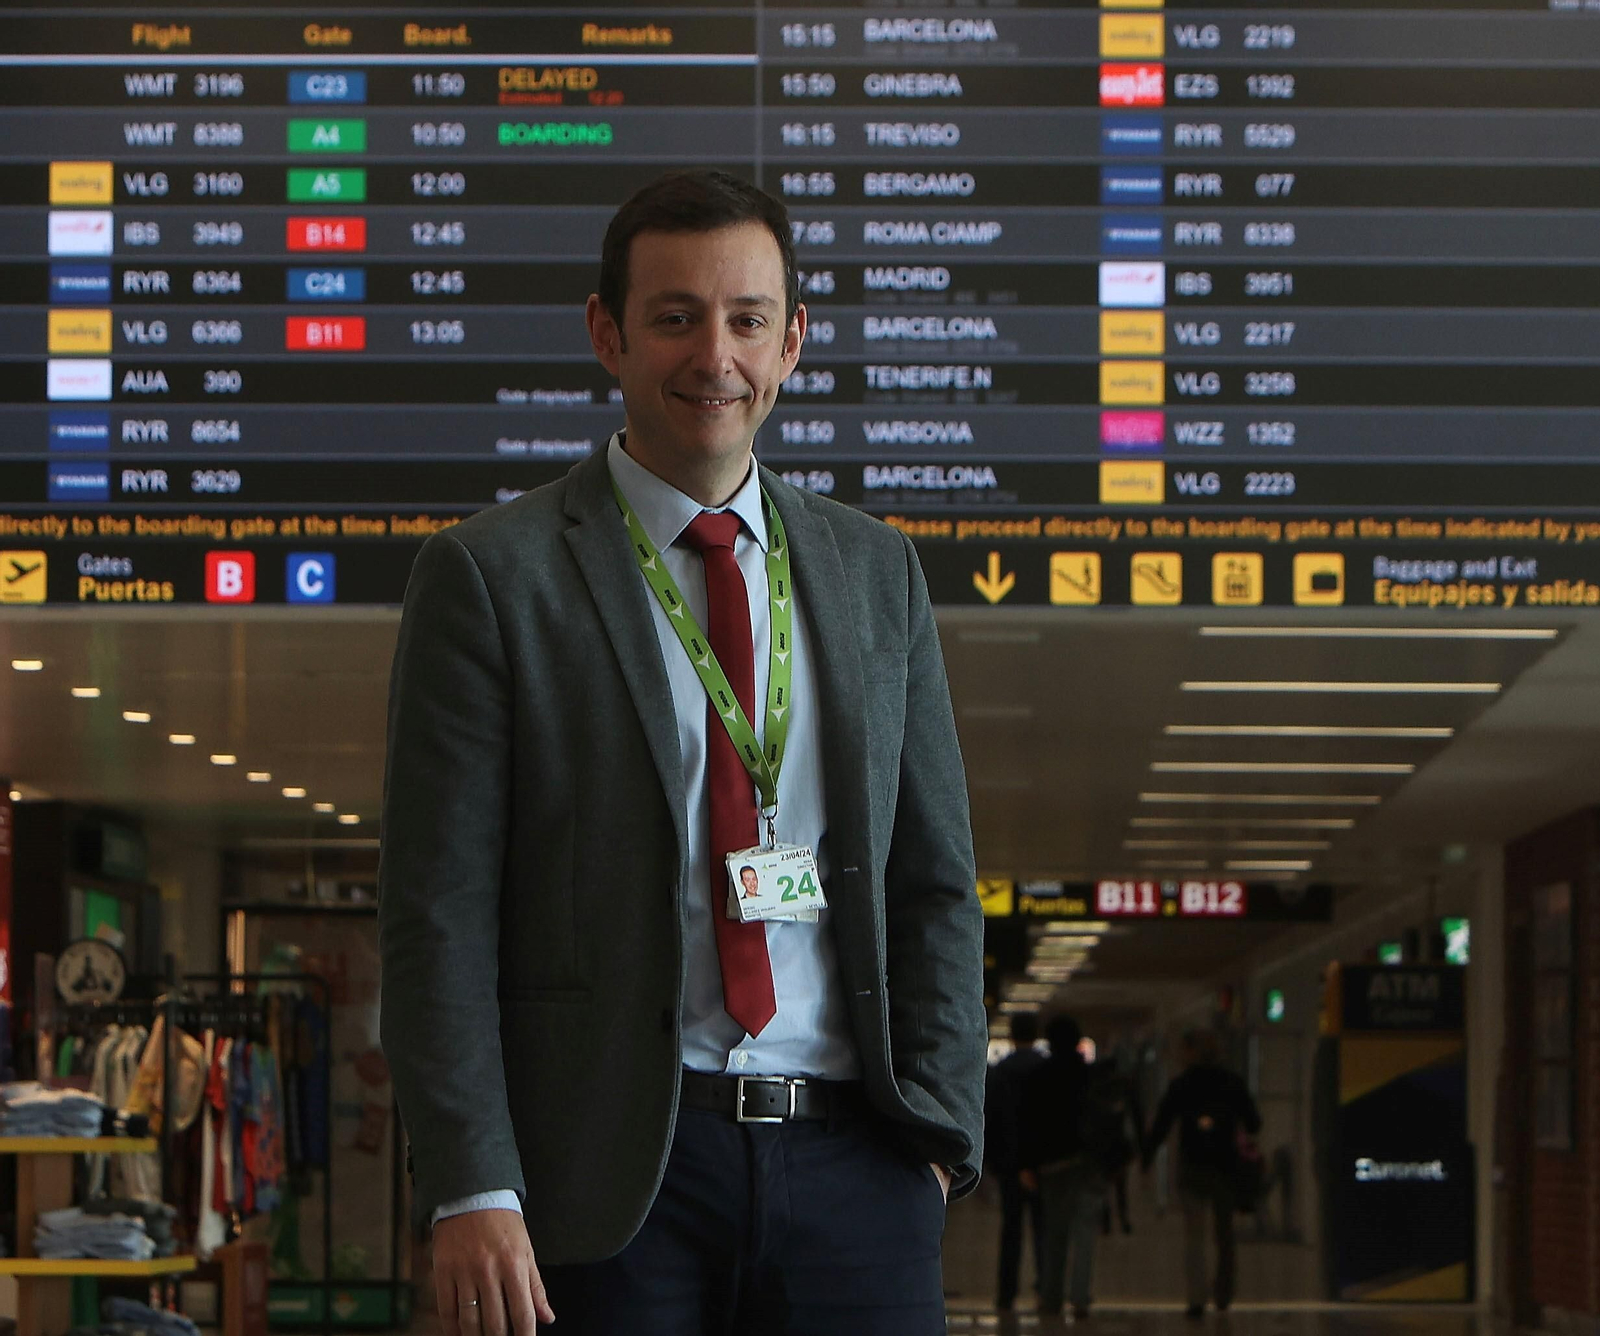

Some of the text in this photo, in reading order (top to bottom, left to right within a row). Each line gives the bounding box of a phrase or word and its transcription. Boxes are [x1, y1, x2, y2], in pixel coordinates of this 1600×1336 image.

[582, 24, 672, 44] Remarks
[782, 24, 835, 46] 15:15
[865, 19, 997, 41] BARCELONA
[1174, 25, 1220, 48] VLG
[125, 73, 177, 95] WMT
[306, 75, 348, 98] C23
[498, 67, 598, 91] DELAYED
[782, 73, 835, 95] 15:50
[864, 73, 962, 96] GINEBRA
[1175, 74, 1218, 97] EZS
[124, 123, 176, 144] WMT
[312, 125, 340, 146] A4
[412, 123, 465, 145] 10:50
[498, 123, 612, 144] BOARDING
[782, 123, 835, 145] 16:15
[866, 123, 960, 146] TREVISO
[1175, 124, 1221, 144] RYR
[124, 172, 168, 195] VLG
[311, 173, 341, 196] A5
[412, 173, 465, 195] 12:00
[864, 173, 975, 195] BERGAMO
[1175, 173, 1222, 194] RYR
[1256, 174, 1294, 196] 077
[124, 222, 160, 244] IBS
[306, 223, 345, 246] B14
[412, 222, 464, 244] 12:45
[791, 221, 836, 245] 7:05
[864, 222, 1001, 243] ROMA CIAMP
[1175, 222, 1221, 243] RYR
[124, 271, 169, 291] RYR
[305, 273, 346, 295] C24
[412, 271, 464, 293] 12:45
[864, 267, 950, 289] MADRID
[1175, 272, 1212, 295] IBS
[123, 321, 167, 343] VLG
[306, 322, 342, 345] B11
[411, 321, 464, 342] 13:05
[864, 317, 997, 339] BARCELONA
[1175, 322, 1220, 345] VLG
[1245, 322, 1294, 345] 2217
[122, 371, 168, 392] AUA
[1175, 372, 1220, 394] VLG
[122, 420, 168, 442] RYR
[864, 421, 973, 443] VARSOVIA
[1175, 422, 1223, 444] WZZ
[122, 470, 167, 491] RYR
[864, 466, 996, 488] BARCELONA
[1175, 472, 1220, 494] VLG
[1245, 473, 1295, 495] 2223
[72, 515, 95, 536] to
[98, 515, 132, 536] the
[134, 515, 226, 540] boarding
[230, 515, 276, 540] gate
[279, 515, 304, 536] at
[305, 515, 340, 536] the
[342, 515, 388, 536] time
[391, 514, 459, 535] indic
[957, 516, 1042, 541] proceed
[1044, 516, 1123, 541] directly
[1126, 516, 1150, 537] to
[1151, 516, 1186, 537] the
[1189, 517, 1281, 542] boarding
[1286, 518, 1332, 542] gate
[1335, 519, 1355, 538] at
[1358, 517, 1394, 538] the
[1396, 517, 1443, 538] time
[1445, 517, 1541, 538] indicated
[1543, 518, 1572, 543] by
[77, 552, 133, 577] Gates
[1373, 555, 1458, 583] Baggage
[1460, 556, 1498, 580] and
[78, 576, 175, 602] Puertas
[217, 560, 243, 597] B
[296, 560, 325, 598] C
[1373, 579, 1497, 610] Equipajes
[1501, 583, 1520, 610] y
[777, 871, 817, 903] 24
[1097, 880, 1157, 913] B11
[1181, 880, 1243, 913] B12
[1018, 895, 1087, 915] Puertas
